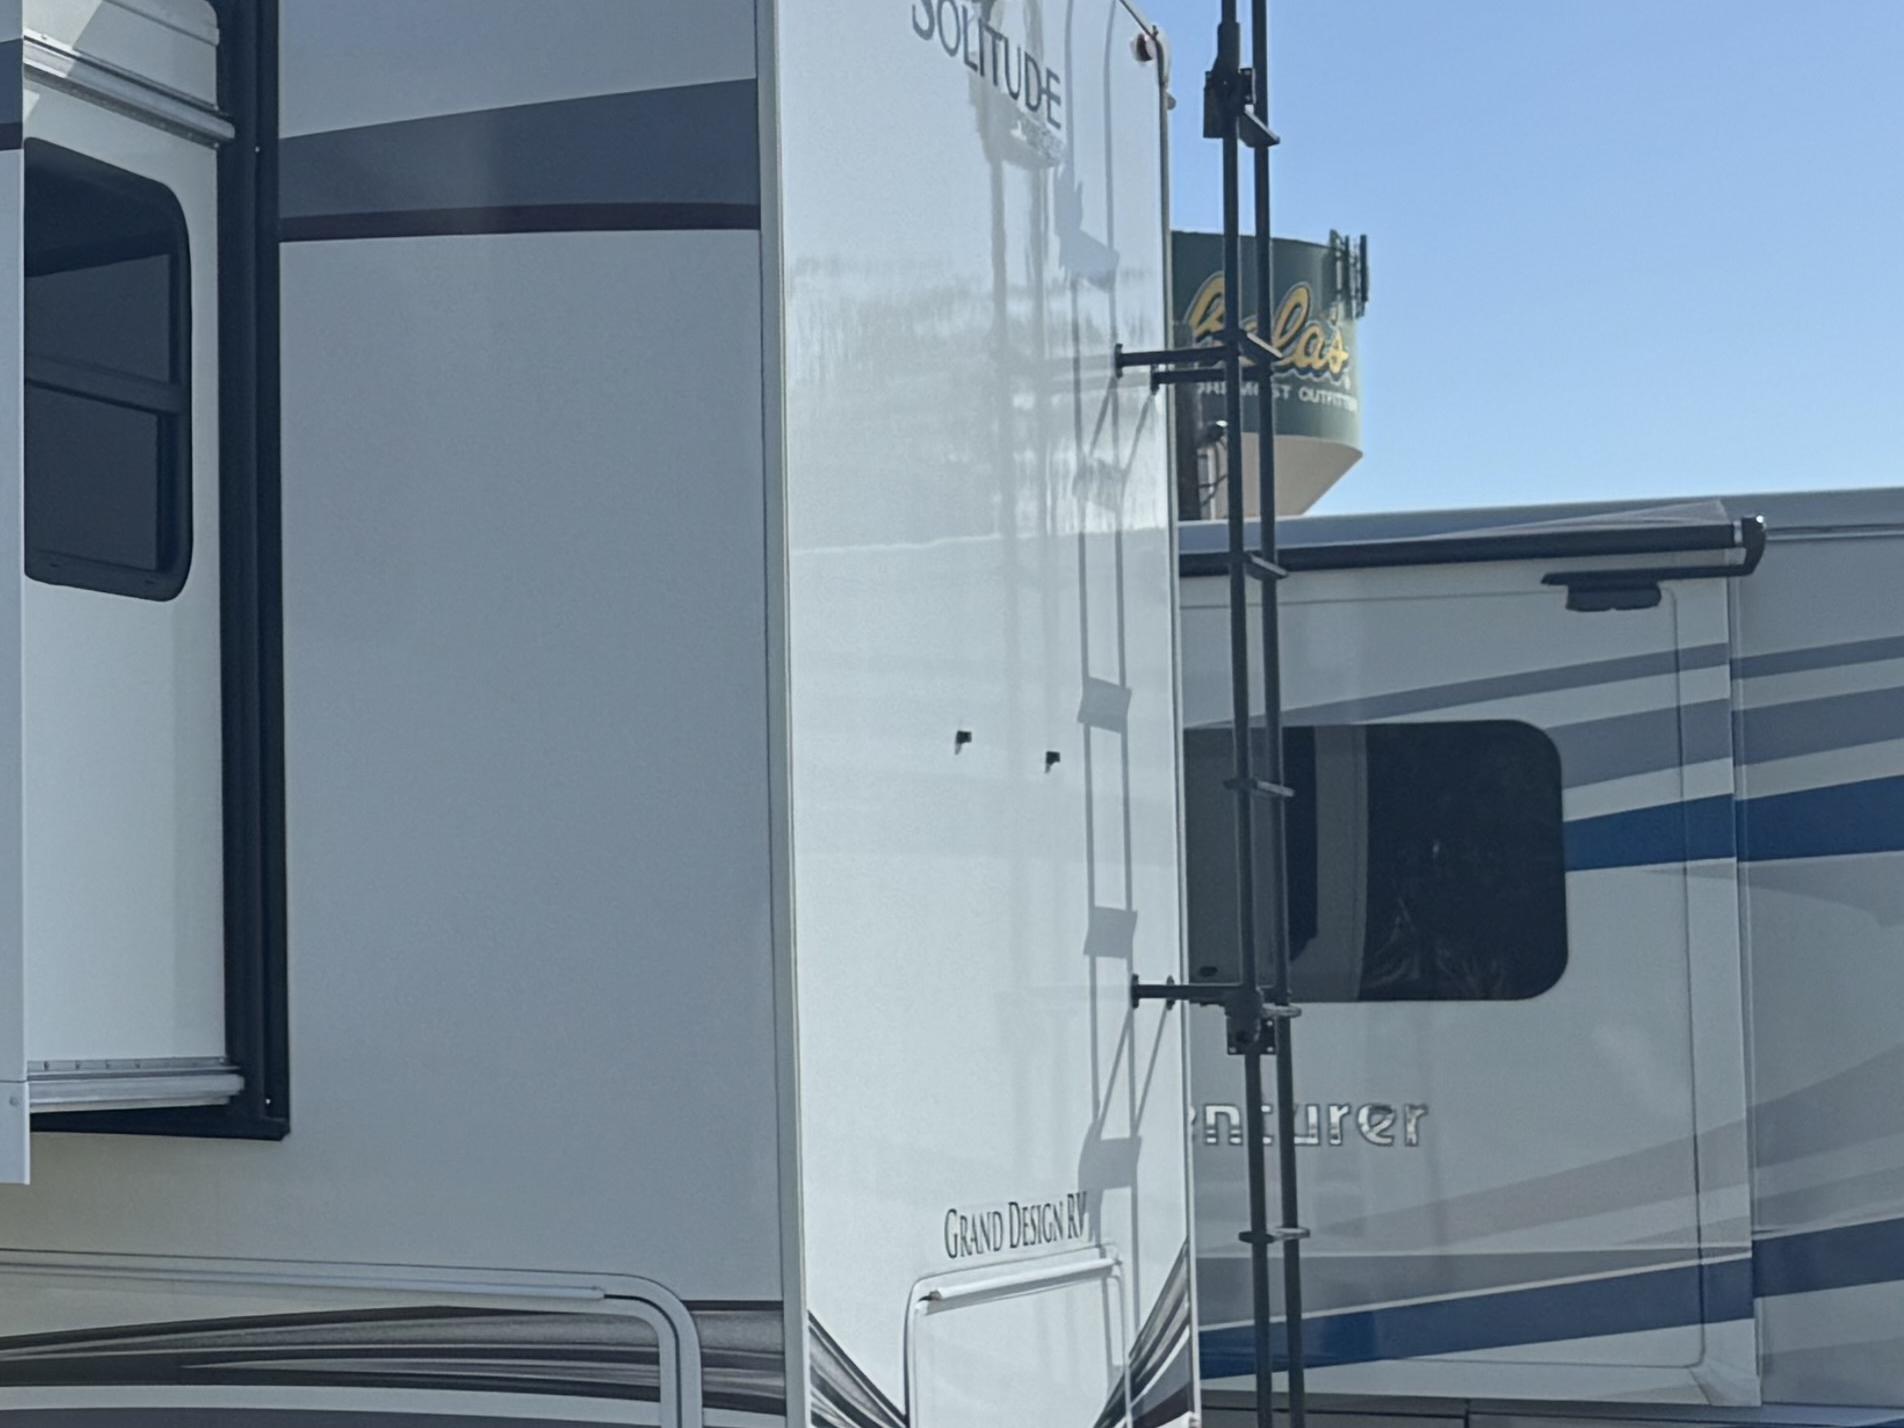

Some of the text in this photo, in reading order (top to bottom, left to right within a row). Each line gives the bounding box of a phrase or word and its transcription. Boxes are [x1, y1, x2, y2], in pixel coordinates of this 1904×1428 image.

[1189, 1103, 1428, 1148] nurer
[944, 1191, 1088, 1259] GRAND DESIGN RV
